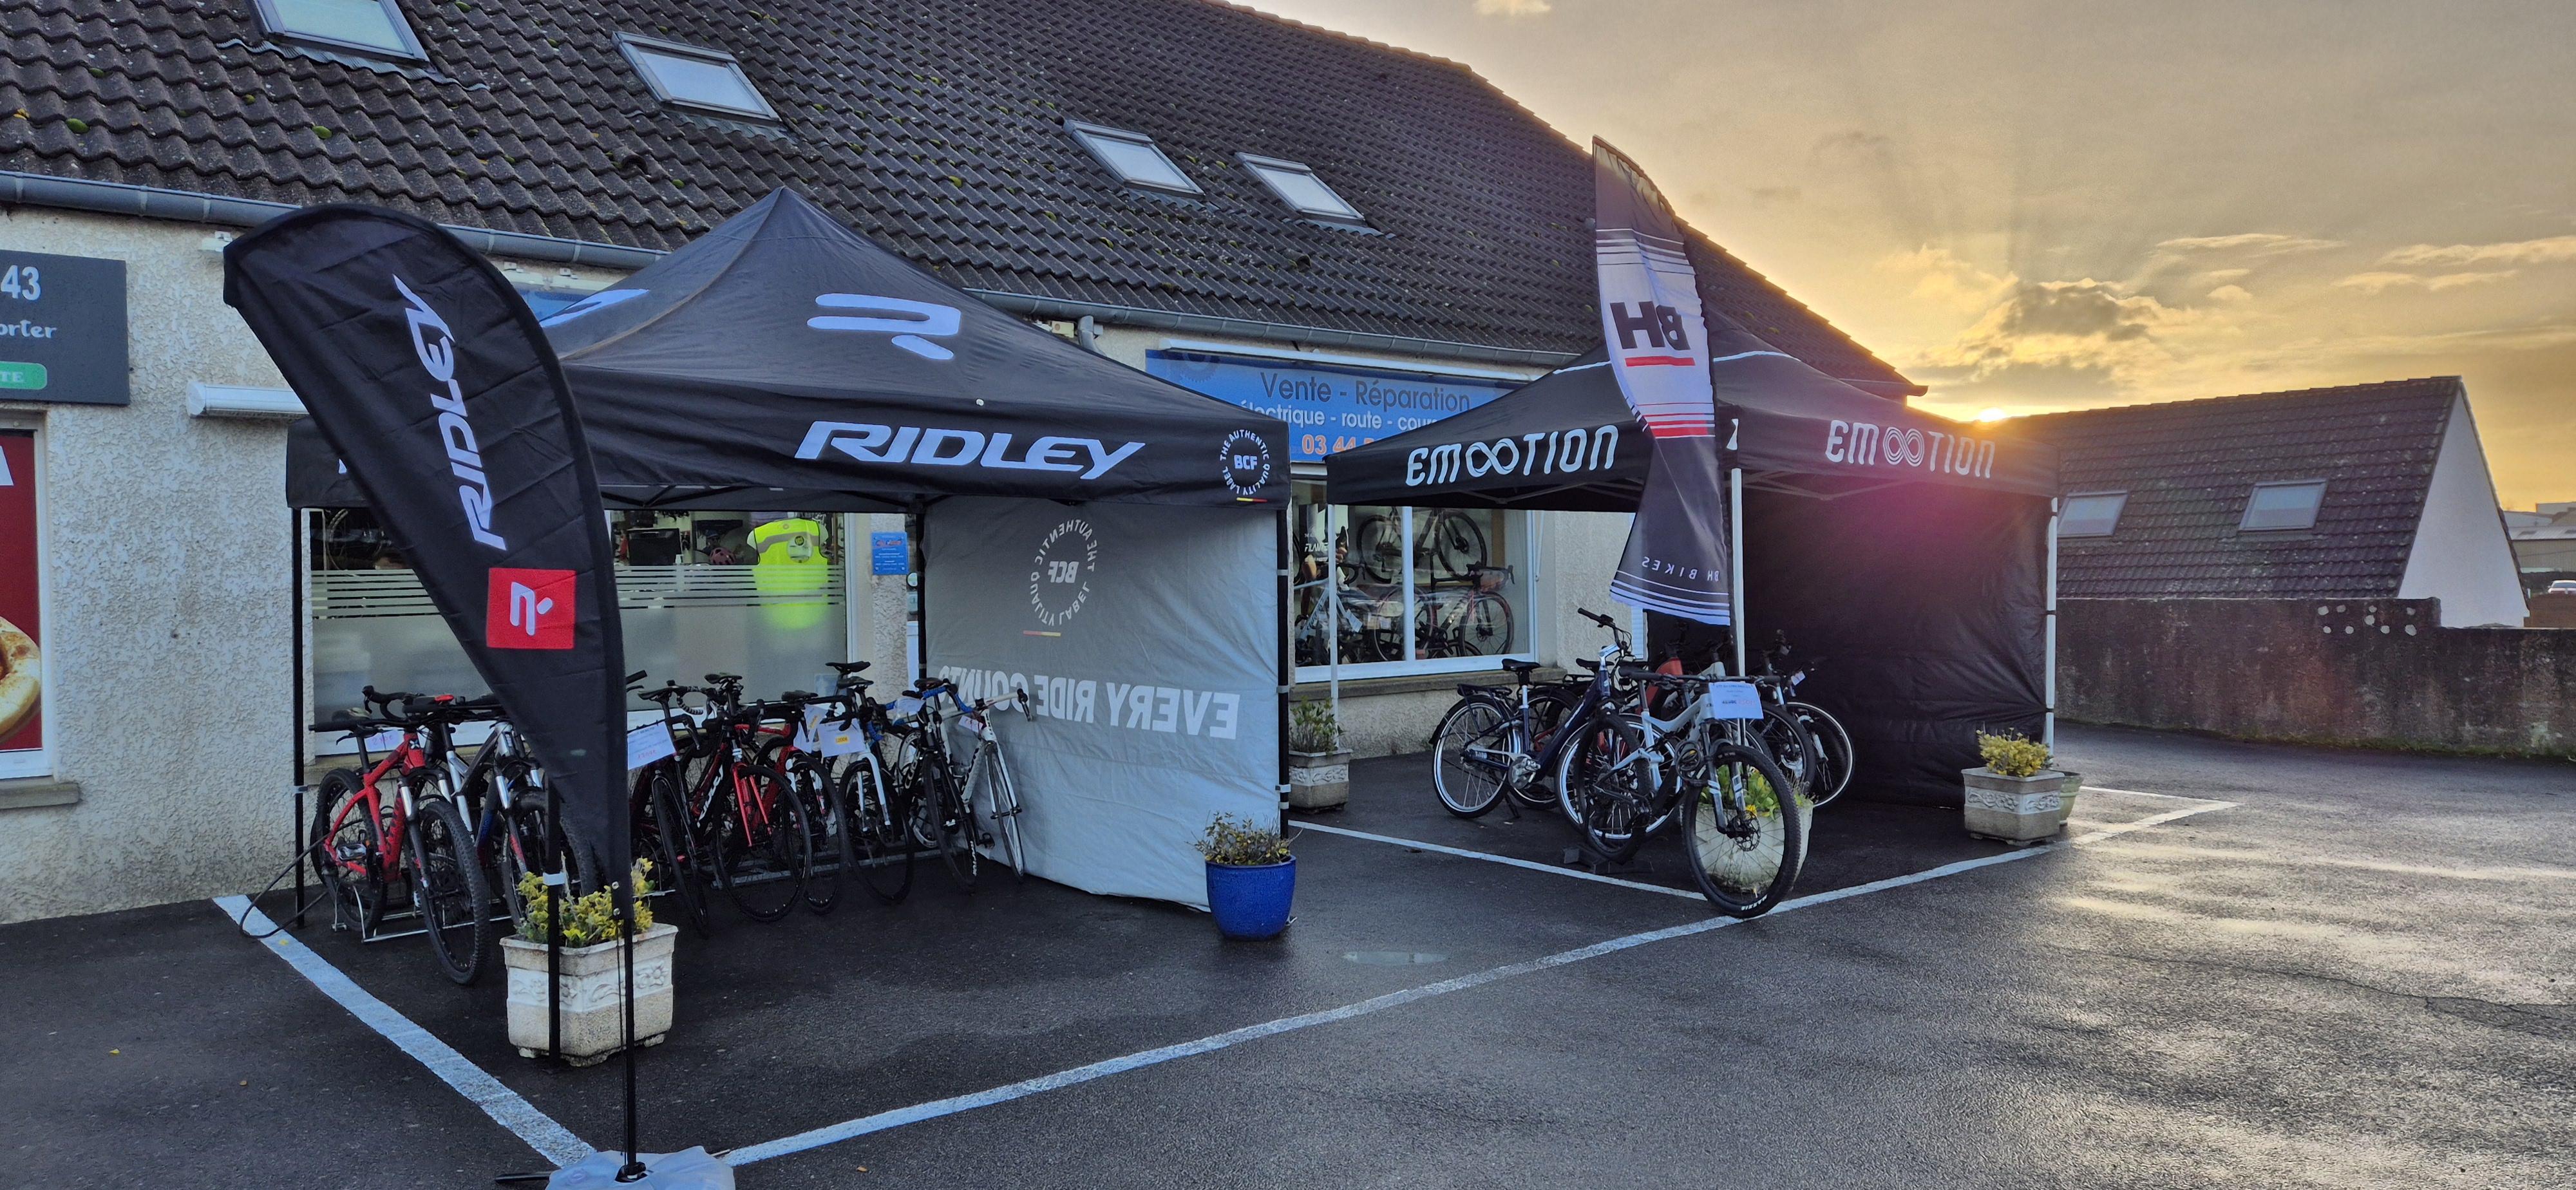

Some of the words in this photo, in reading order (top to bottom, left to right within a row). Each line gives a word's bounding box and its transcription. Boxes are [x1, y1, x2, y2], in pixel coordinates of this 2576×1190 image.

[1, 265, 41, 300] 43
[1260, 372, 1331, 402] Vente
[1356, 380, 1470, 412] Réparation
[392, 274, 507, 551] RIDLEY
[1341, 411, 1382, 430] route
[795, 420, 1146, 480] RIDLEY
[1220, 440, 1231, 461] THE
[1228, 429, 1270, 460] AUTHENTIC
[1302, 434, 1327, 455] 03
[1332, 435, 1356, 453] 44
[1233, 454, 1258, 469] BCF
[1222, 466, 1240, 495] LABEL
[1242, 463, 1271, 496] QUALITY
